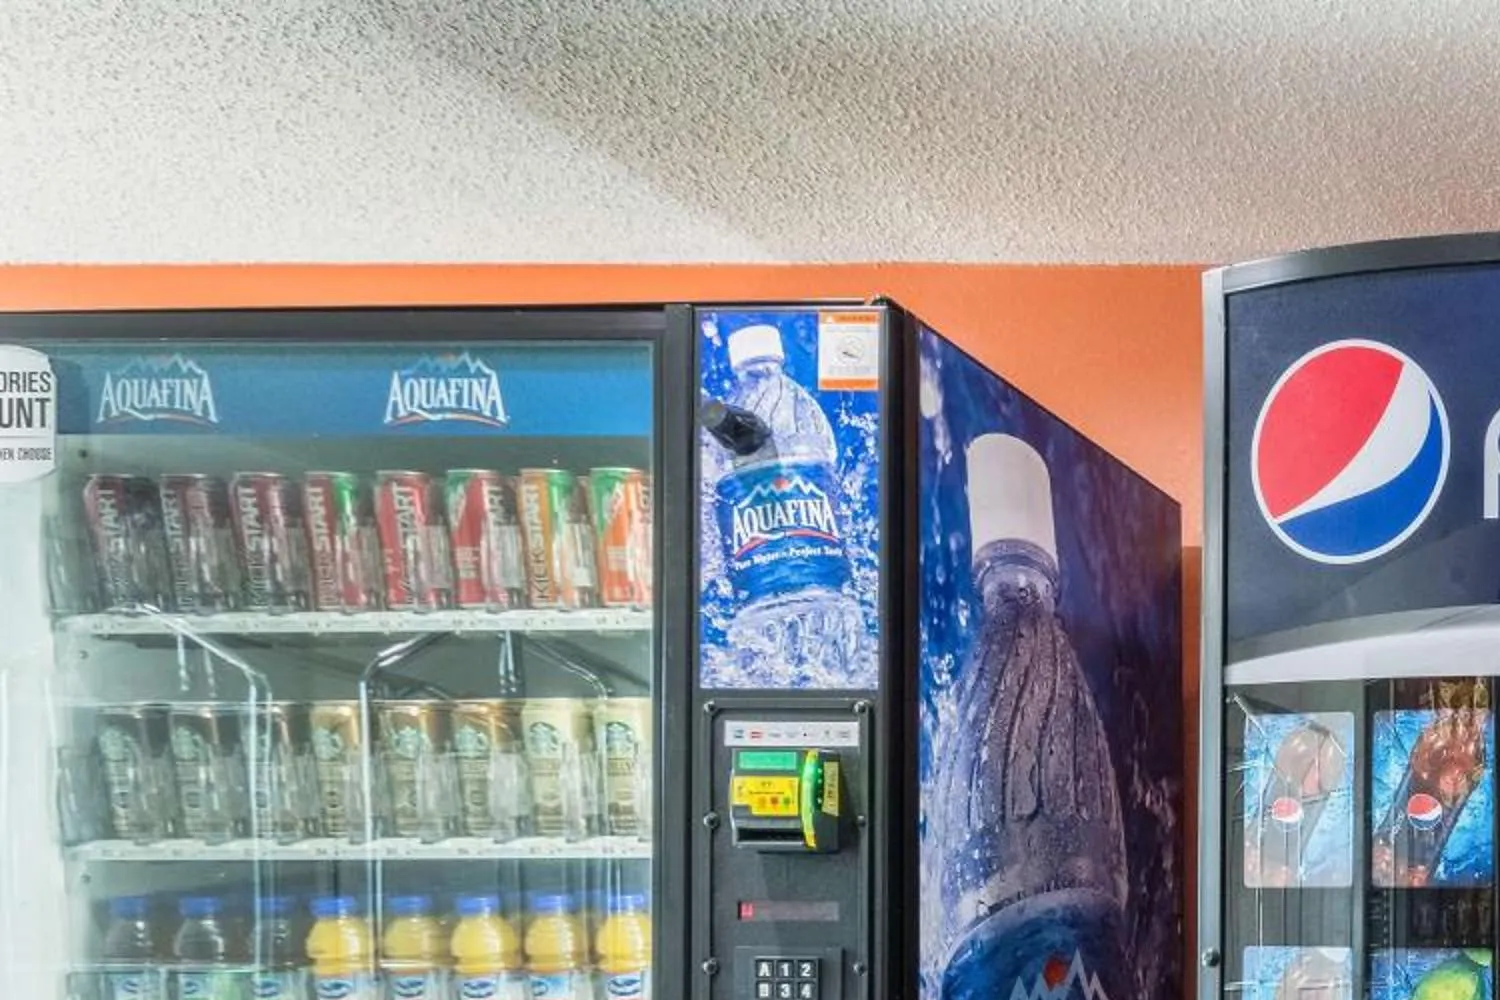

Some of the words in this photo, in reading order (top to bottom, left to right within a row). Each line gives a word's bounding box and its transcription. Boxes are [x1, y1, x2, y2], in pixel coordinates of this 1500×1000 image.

[96, 371, 219, 424] AQUAFINA
[383, 369, 510, 424] AQUAFINA
[732, 495, 841, 557] AQUAFINA
[758, 961, 771, 977] A
[781, 961, 790, 977] 1
[801, 961, 811, 977] 2
[780, 983, 791, 998] 3
[801, 983, 812, 998] 4
